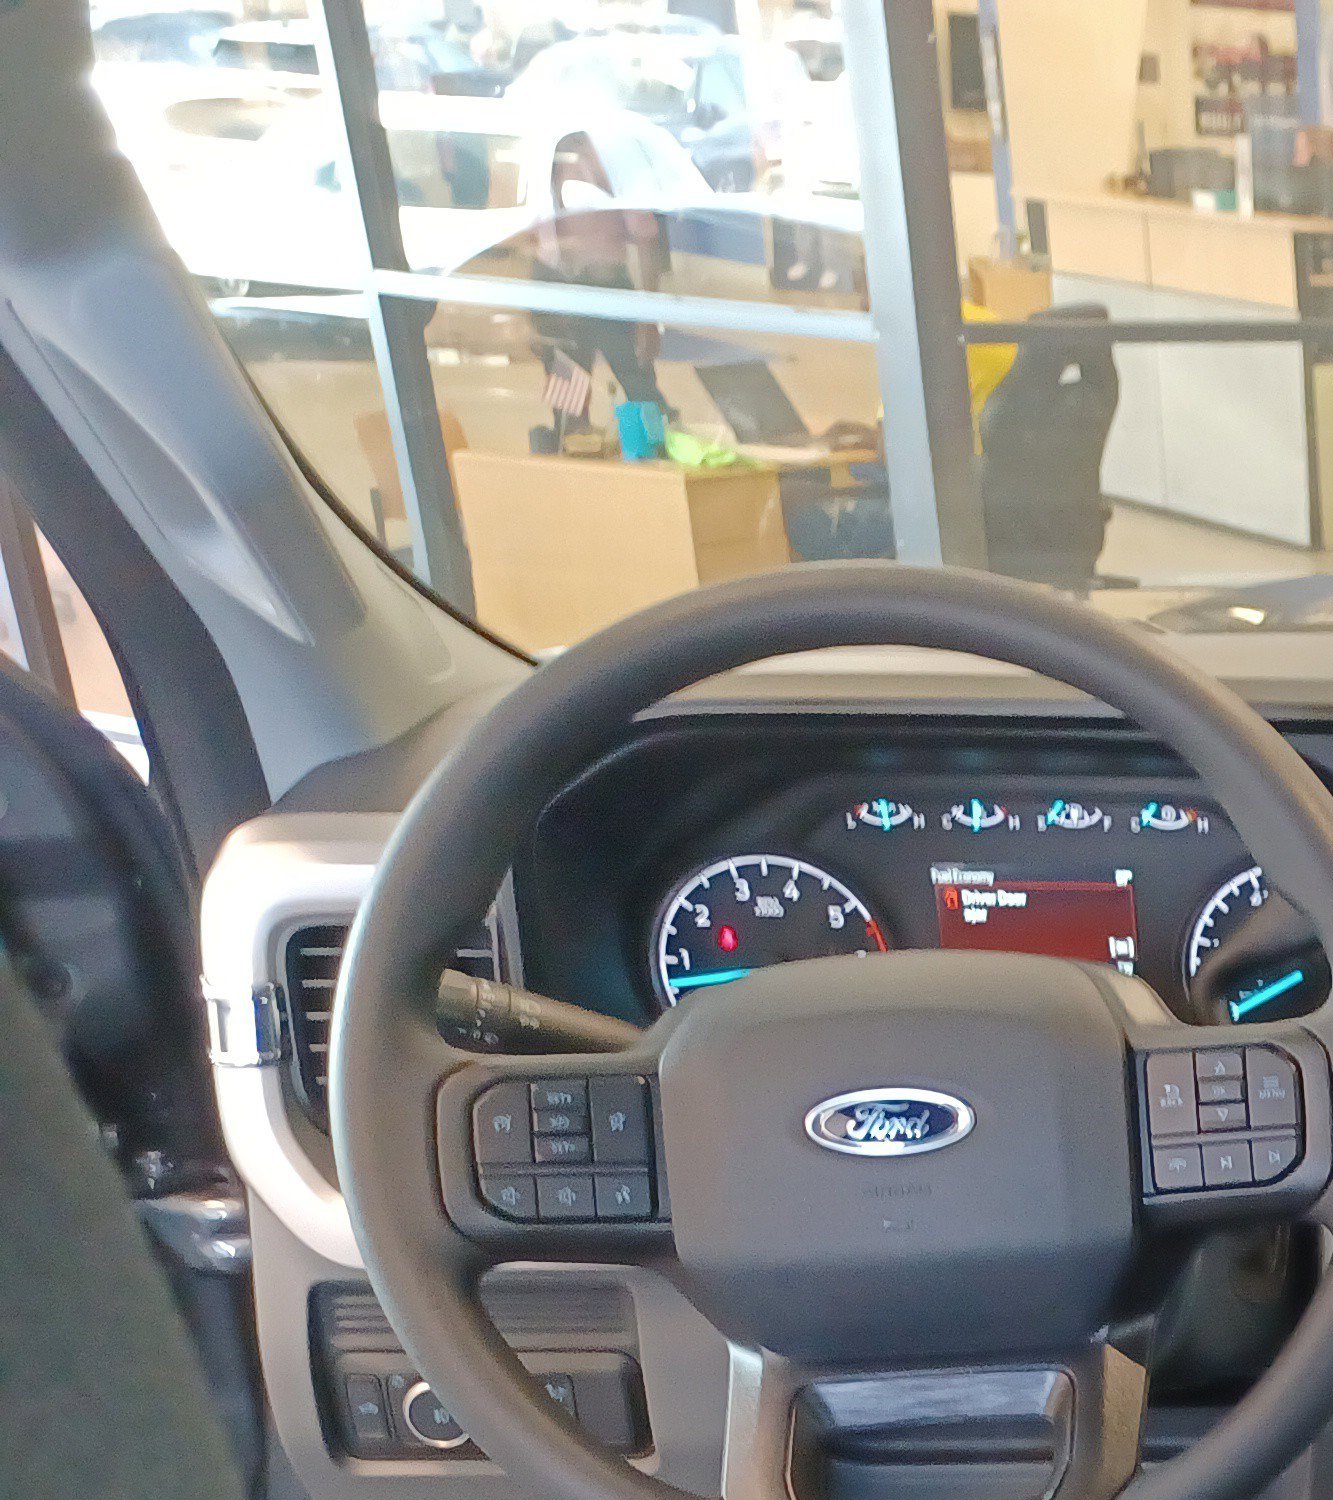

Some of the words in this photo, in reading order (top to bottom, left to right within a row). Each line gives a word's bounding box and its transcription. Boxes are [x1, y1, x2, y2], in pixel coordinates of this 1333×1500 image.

[734, 877, 751, 902] 3
[782, 878, 801, 902] 4
[694, 903, 712, 928] 2
[827, 904, 845, 930] 5
[678, 947, 691, 971] 1
[845, 1102, 930, 1142] Ford
